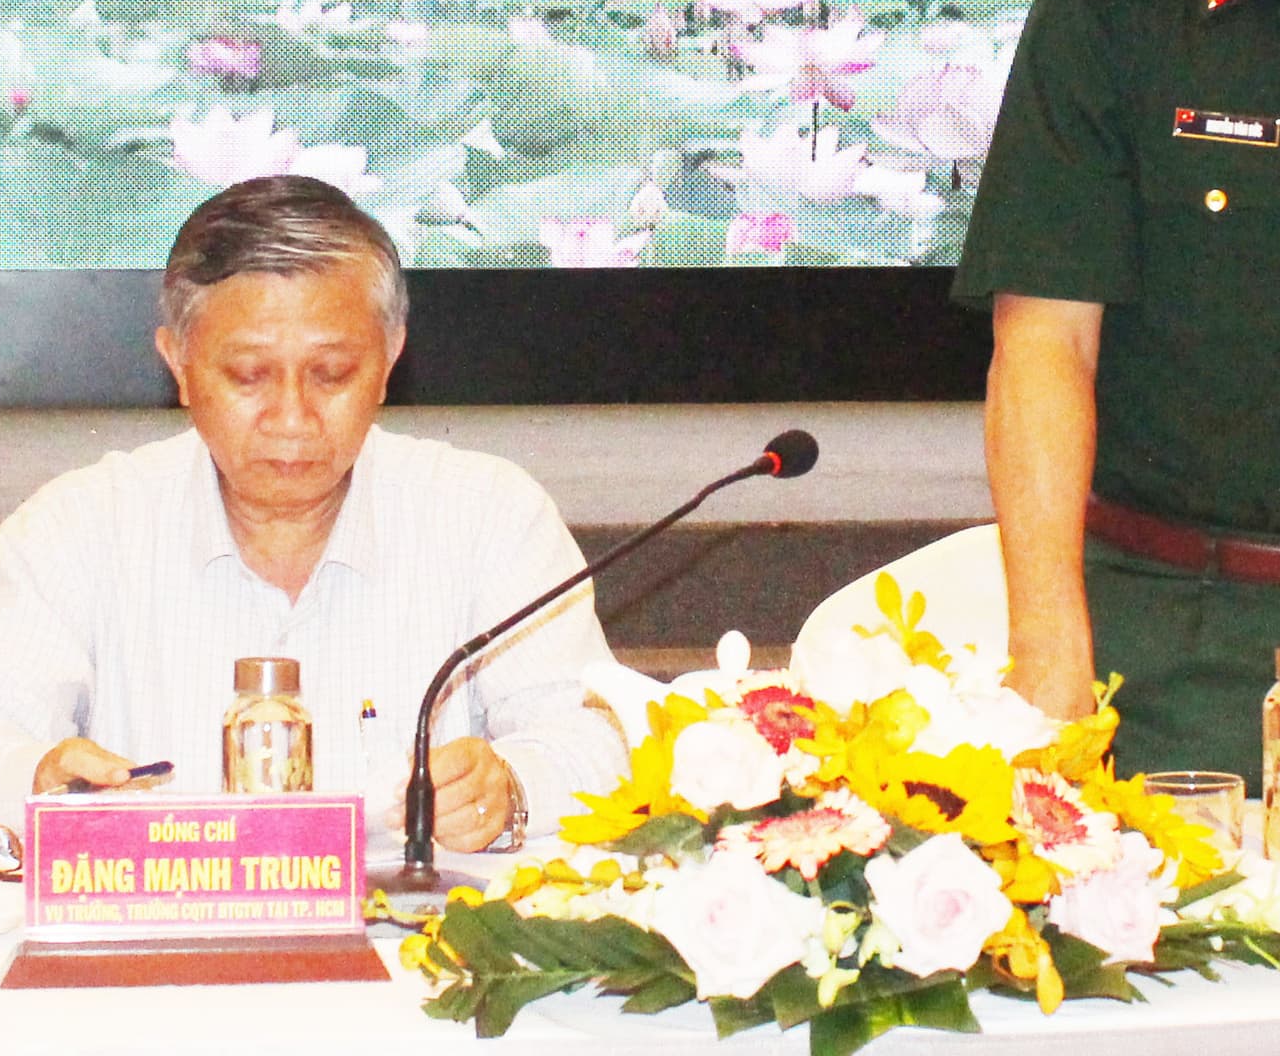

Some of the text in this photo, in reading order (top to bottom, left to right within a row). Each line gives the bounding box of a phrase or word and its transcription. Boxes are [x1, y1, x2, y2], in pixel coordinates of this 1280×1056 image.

[203, 815, 237, 842] CHÍ
[51, 851, 342, 903] ĐẶNG MẠNH TRUNG
